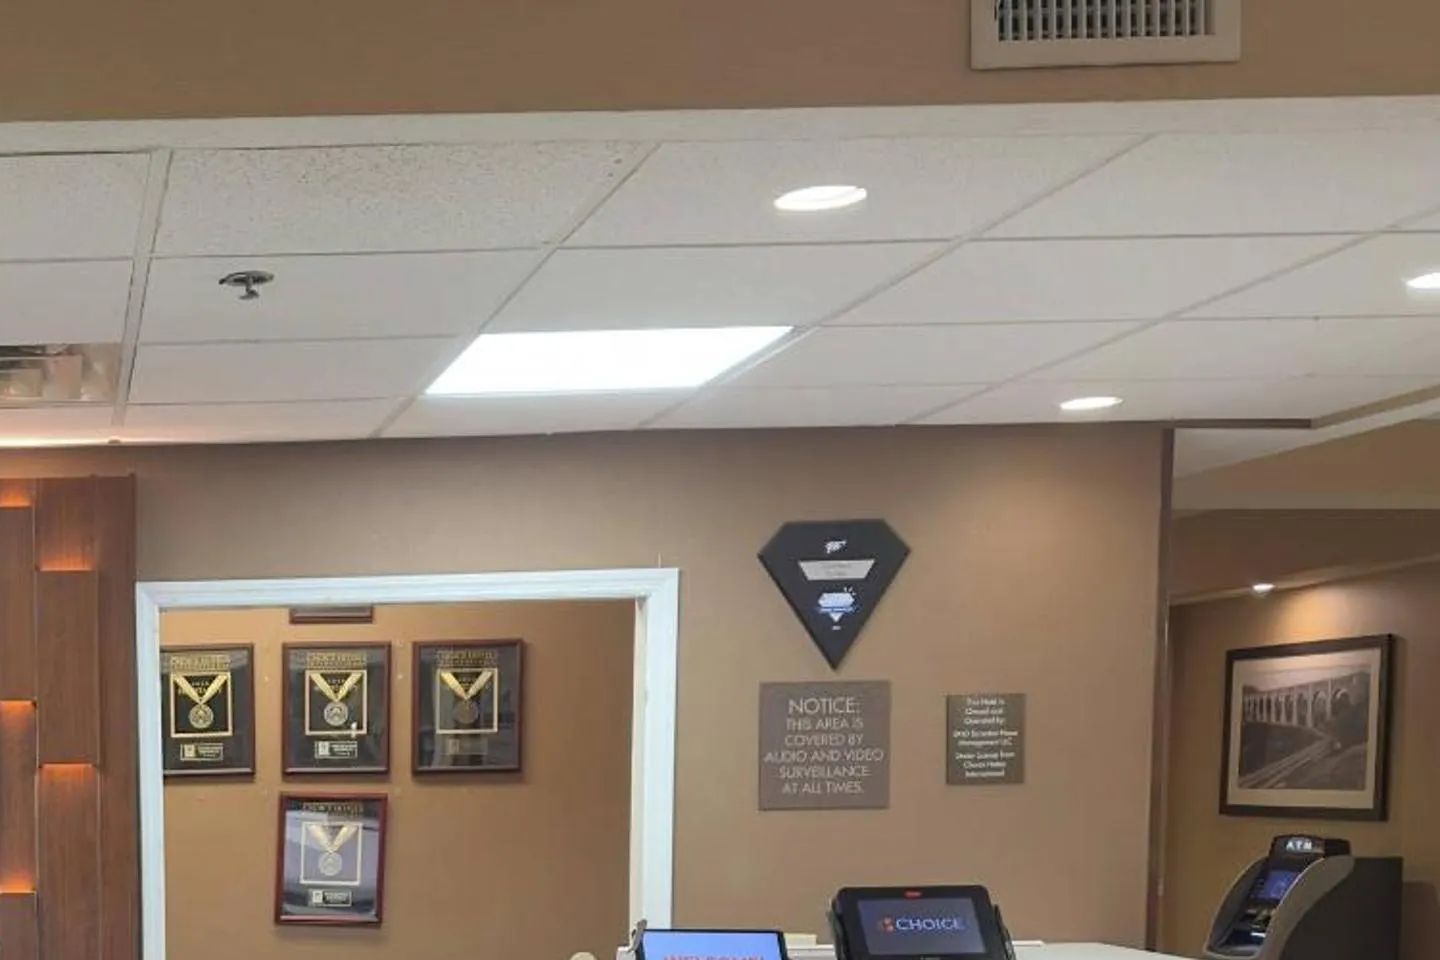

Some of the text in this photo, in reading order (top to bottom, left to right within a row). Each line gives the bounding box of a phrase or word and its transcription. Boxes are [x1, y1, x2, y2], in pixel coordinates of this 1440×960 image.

[786, 717, 864, 731] THIS AREA IS
[784, 733, 864, 746] COVERED BY
[764, 748, 884, 762] AUDIO AND VIDEO
[778, 765, 871, 779] SURVEILLANCE
[782, 782, 799, 794] AT
[802, 781, 822, 794] ALL
[1286, 839, 1312, 850] ATM
[895, 917, 966, 931] CHOICE
